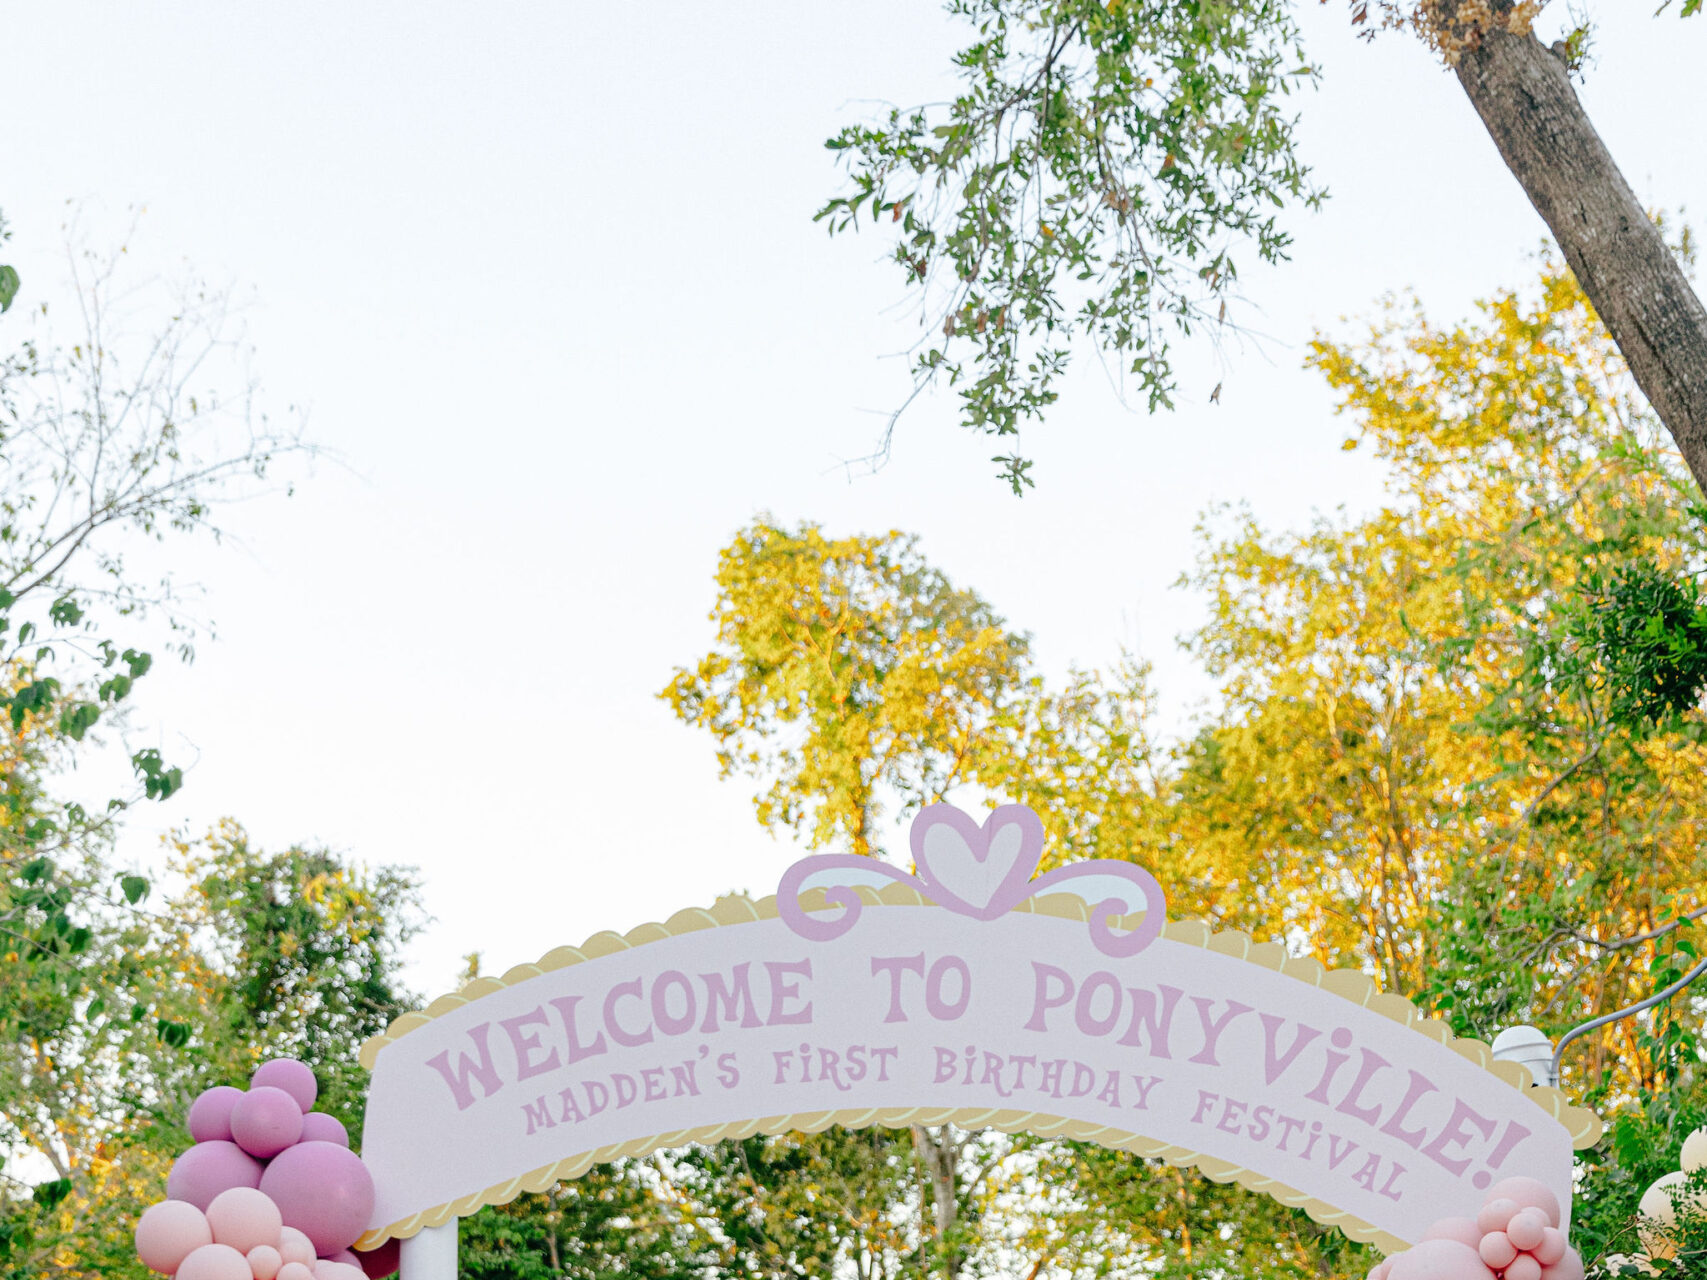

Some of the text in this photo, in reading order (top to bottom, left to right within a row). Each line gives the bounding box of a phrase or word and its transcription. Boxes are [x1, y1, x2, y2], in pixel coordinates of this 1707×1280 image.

[423, 957, 813, 1111] WELCOME
[871, 951, 971, 1024] TO
[521, 1043, 740, 1135] MADDEN'S
